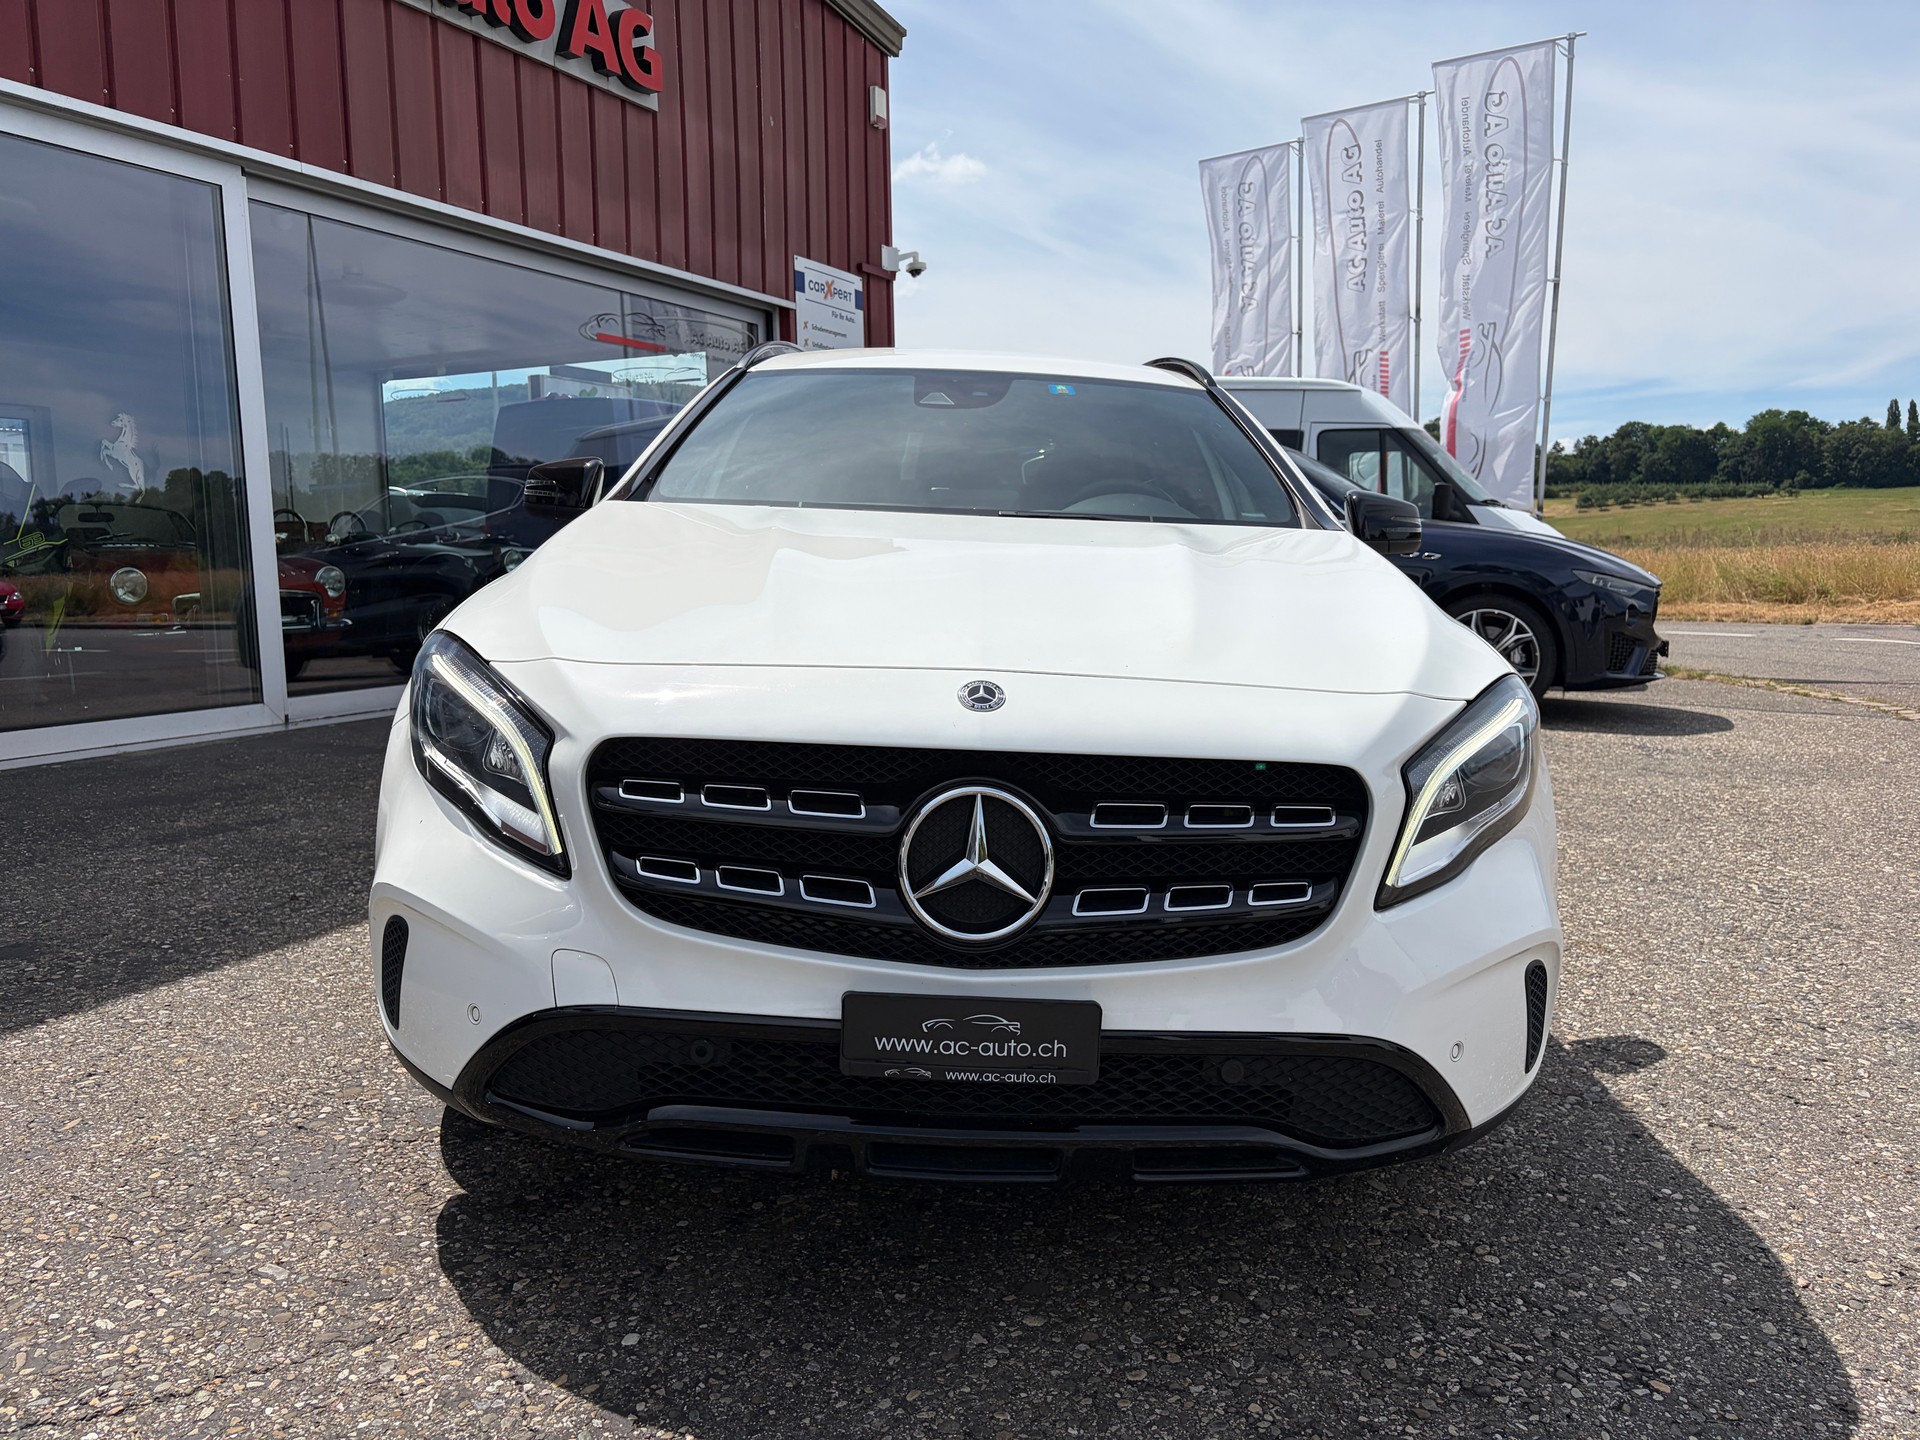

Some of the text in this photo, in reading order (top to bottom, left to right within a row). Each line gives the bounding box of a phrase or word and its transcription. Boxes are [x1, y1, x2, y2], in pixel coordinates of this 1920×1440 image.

[557, 0, 663, 93] AG
[1340, 143, 1368, 293] AC Auto AG
[1374, 139, 1387, 342] Werkstatt Spenglerei Malerei Autohandel
[874, 1036, 1067, 1058] www.ac-auto.ch
[945, 1071, 1056, 1084] www.ac-auto.ch
